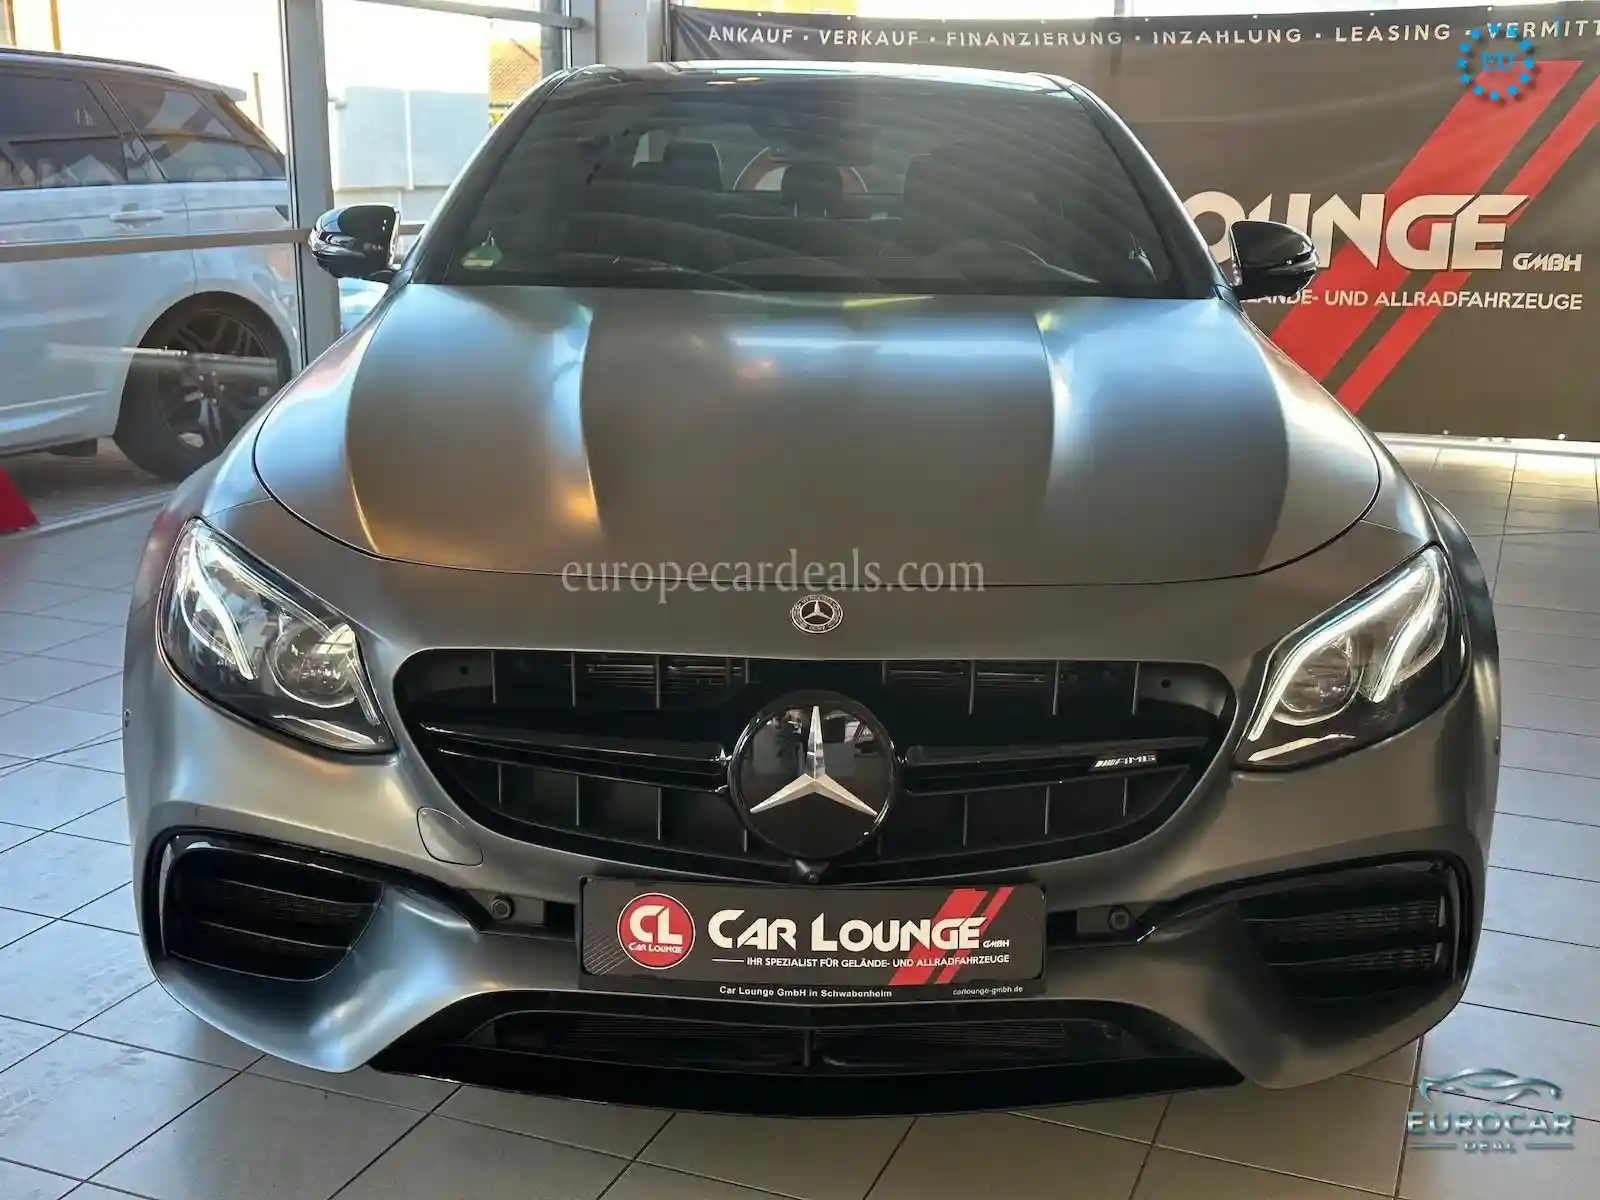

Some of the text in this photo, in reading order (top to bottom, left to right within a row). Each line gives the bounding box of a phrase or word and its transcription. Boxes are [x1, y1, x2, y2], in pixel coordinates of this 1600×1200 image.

[708, 26, 793, 45] ANKAUF
[818, 29, 919, 46] VERKAUF
[946, 31, 1122, 47] FINANZIERUNG
[1153, 28, 1302, 45] INZAHLUNG
[1335, 24, 1451, 42] LEASING
[1512, 252, 1582, 272] GMBH
[1324, 289, 1369, 306] UND
[1374, 291, 1583, 310] ALLRADFAHRZEUGE
[629, 904, 683, 945] CL
[707, 909, 798, 951] CAR
[811, 912, 988, 952] LOUNGE
[628, 941, 683, 954] CAR LOUNGE
[746, 954, 1010, 969] IHR SPEZIALIST FÜR GELÄNDE- UND ALLRADFAHRZEUGE
[719, 985, 737, 995] Car
[738, 986, 774, 998] Lounge
[776, 988, 807, 998] GmbH
[809, 988, 818, 998] in
